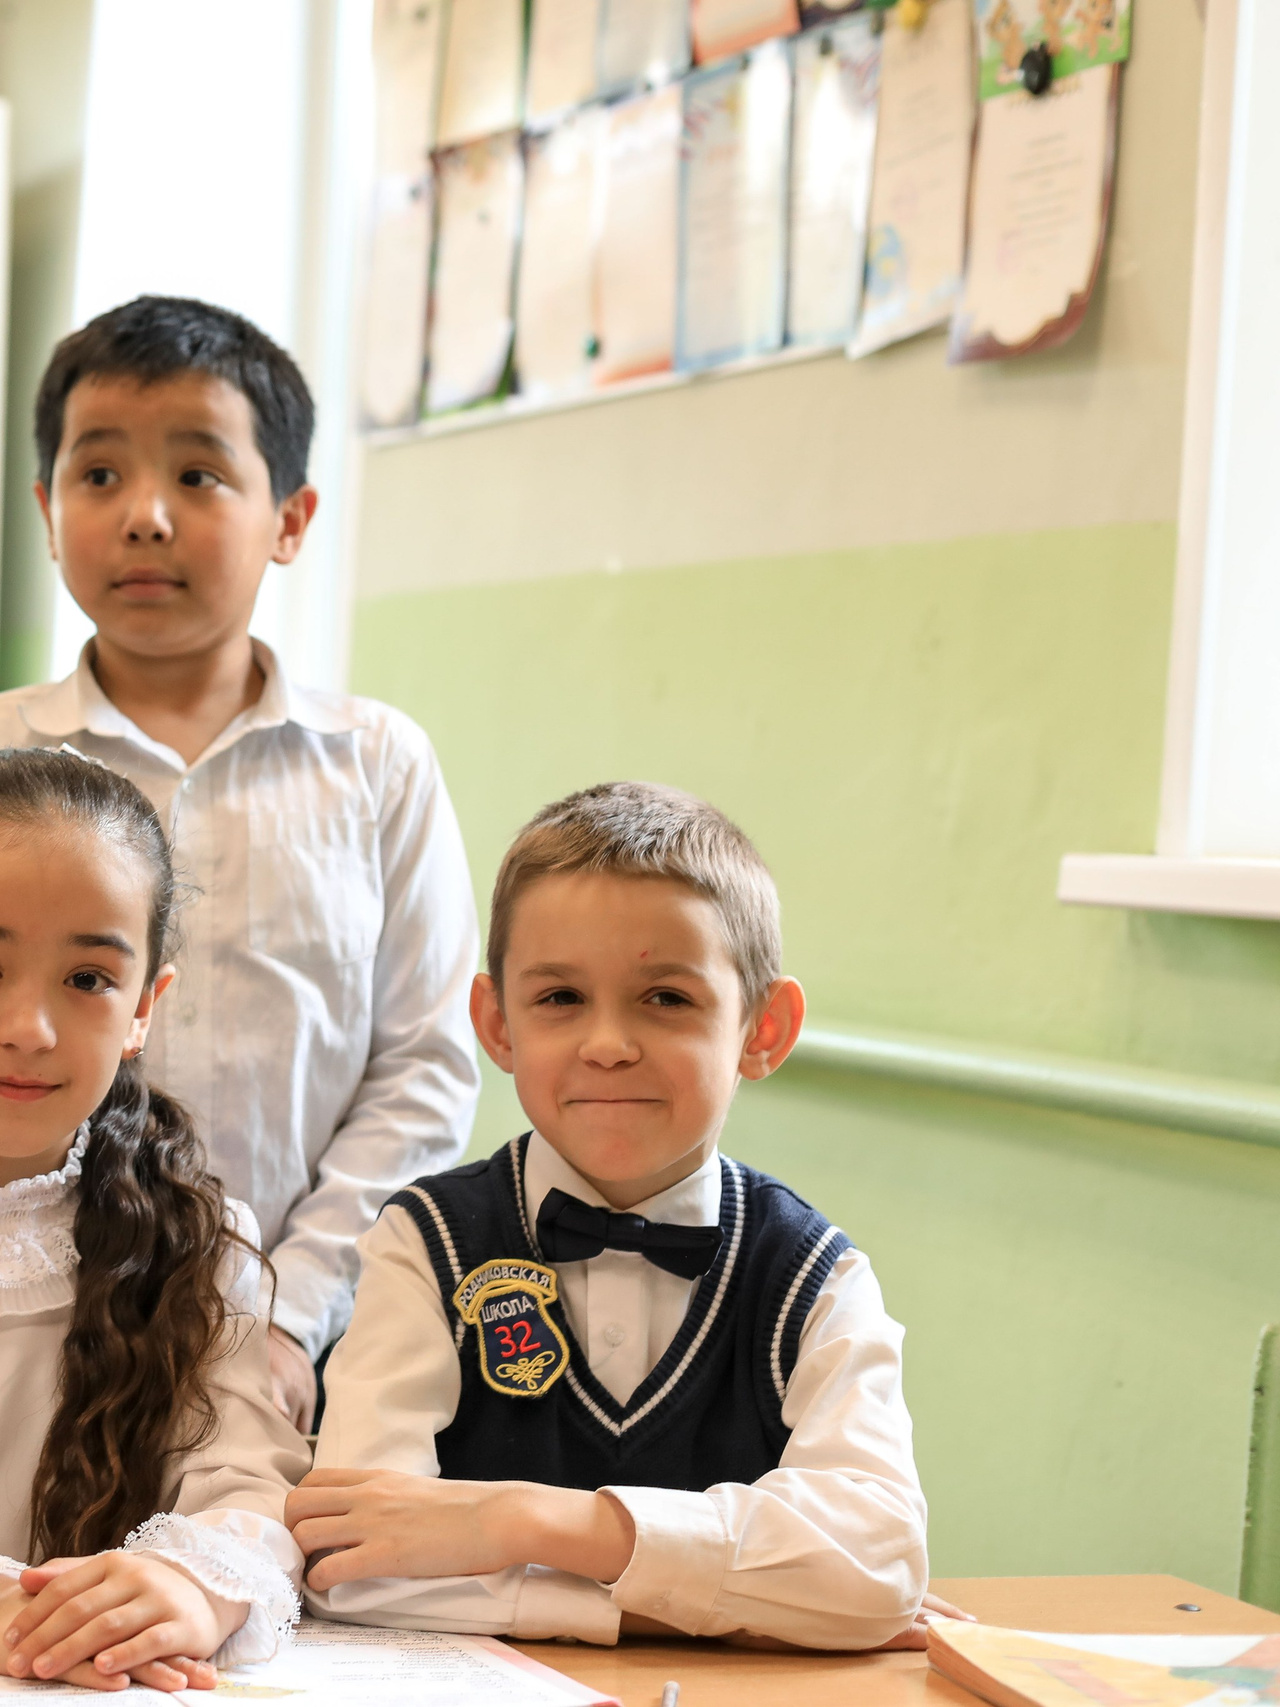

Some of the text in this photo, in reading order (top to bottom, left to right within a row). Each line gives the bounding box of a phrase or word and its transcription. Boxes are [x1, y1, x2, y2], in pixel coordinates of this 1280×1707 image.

[460, 1267, 550, 1308] РОДНИКОВСКАЯ
[482, 1296, 535, 1323] ШКОЛА
[495, 1320, 541, 1358] 32
